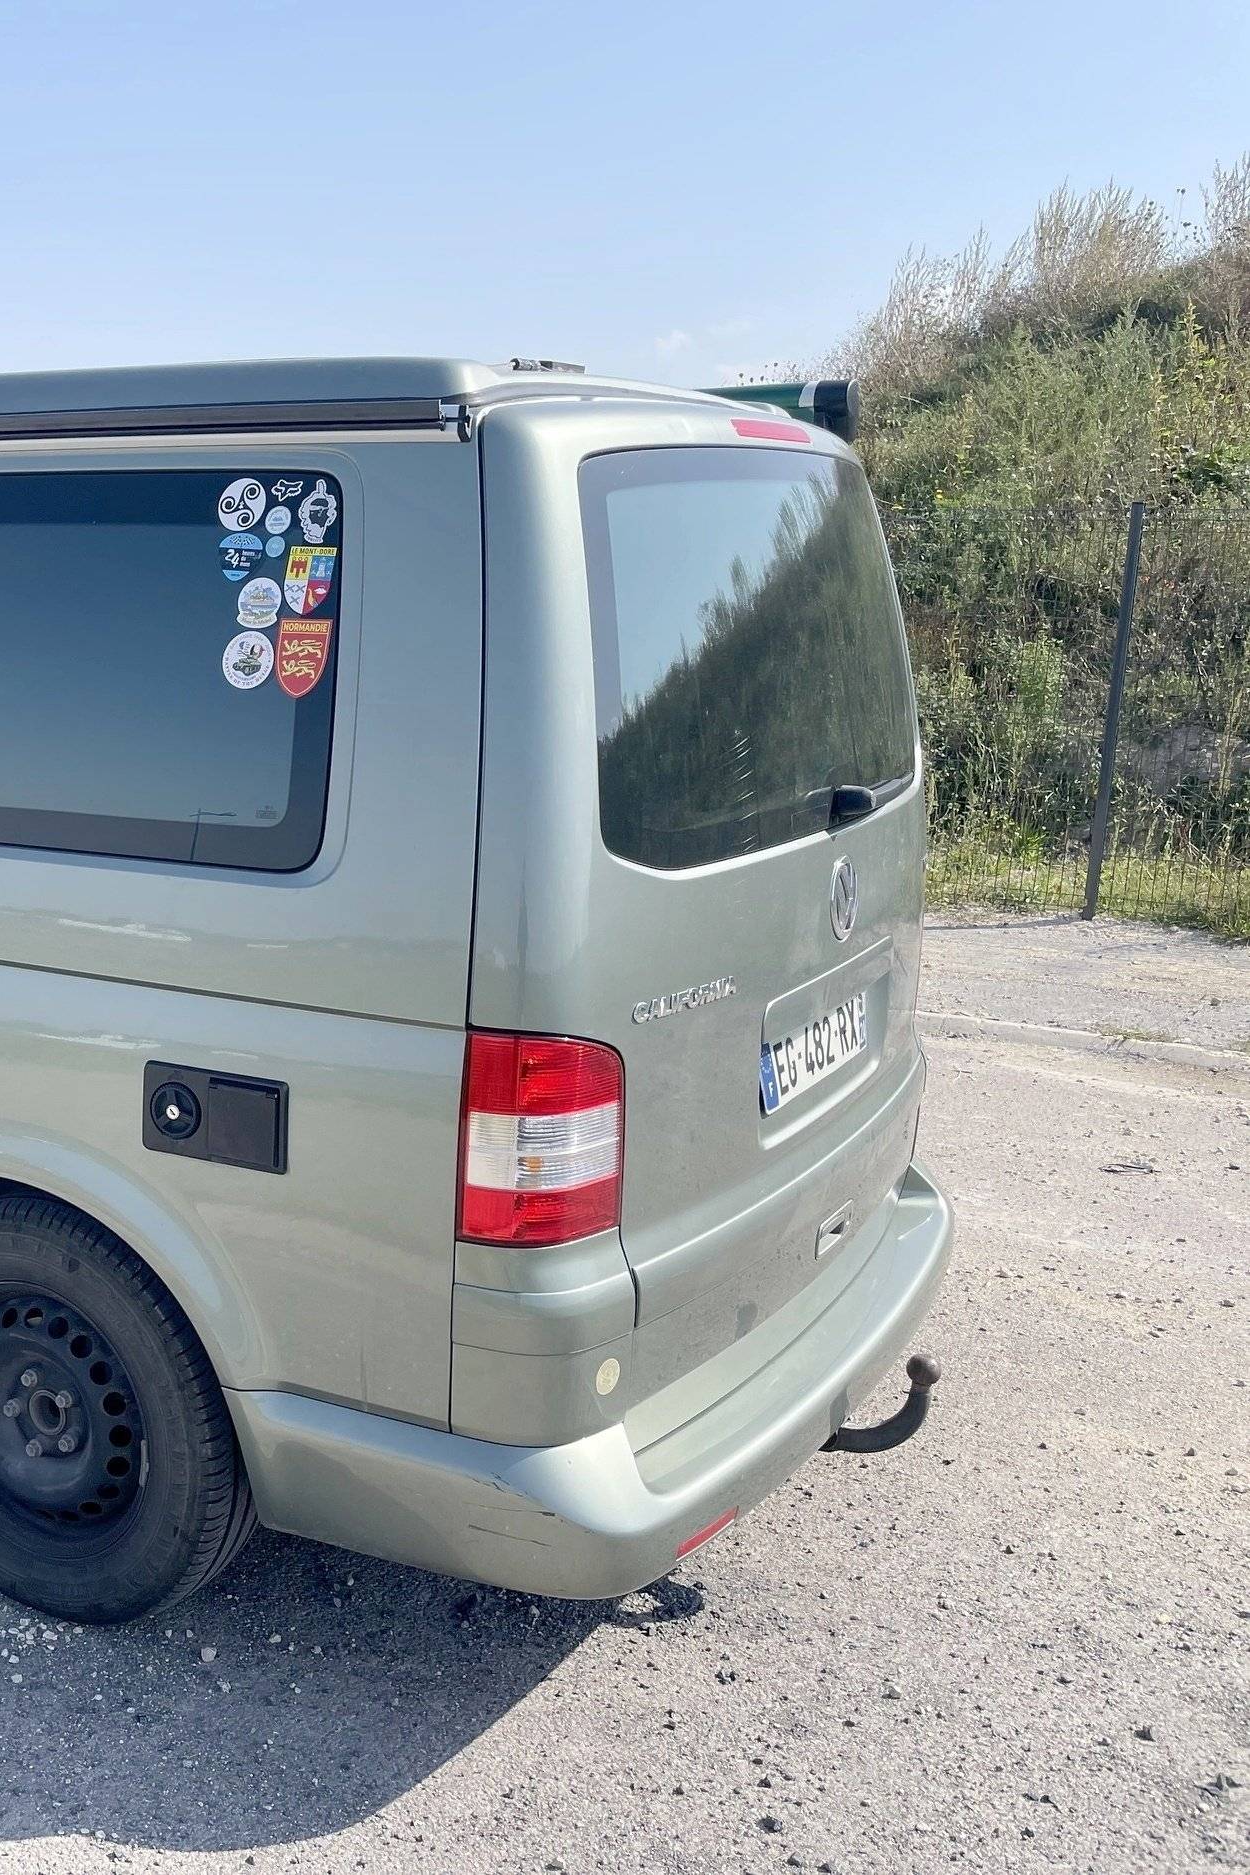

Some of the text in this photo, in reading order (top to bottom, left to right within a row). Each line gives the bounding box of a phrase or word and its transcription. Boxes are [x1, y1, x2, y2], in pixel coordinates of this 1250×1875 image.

[224, 548, 240, 568] 24
[282, 622, 328, 632] NORMANDIE
[632, 975, 737, 1024] CALIFORNIA
[772, 999, 858, 1096] EG-482-RX
